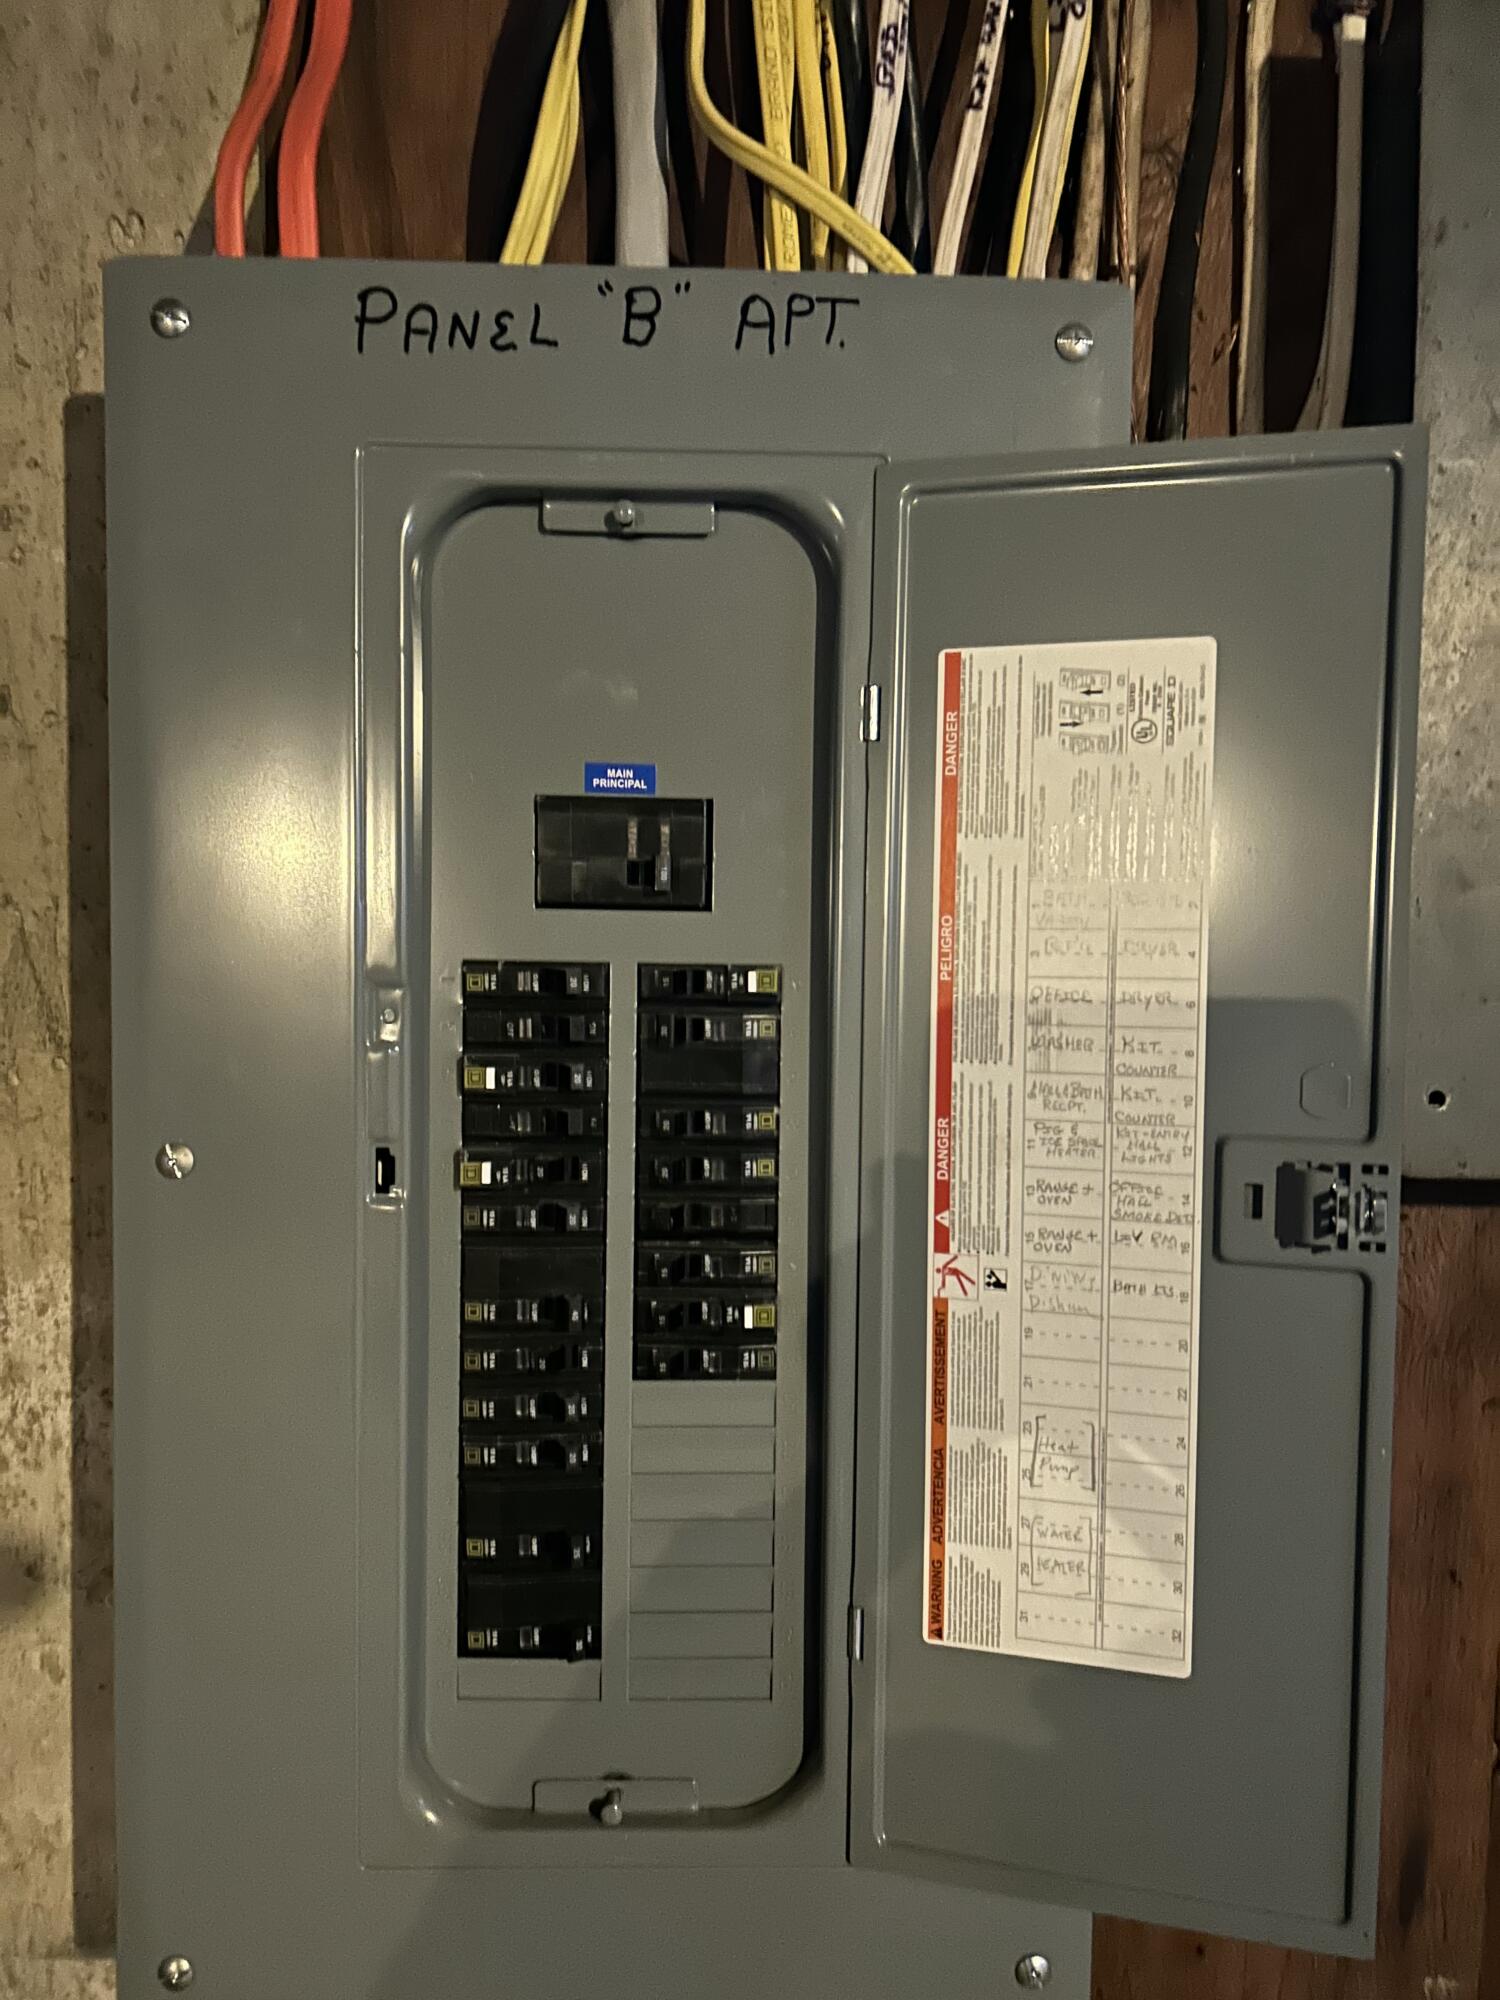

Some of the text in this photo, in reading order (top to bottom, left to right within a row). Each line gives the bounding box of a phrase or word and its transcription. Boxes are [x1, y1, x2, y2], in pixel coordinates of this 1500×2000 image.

[764, 47, 783, 120] BRAND
[356, 285, 558, 356] PANEL
[736, 294, 861, 356] APT.
[1165, 674, 1175, 747] SQUARE D
[944, 710, 958, 776] DANGER
[606, 768, 634, 779] MAIN
[592, 778, 648, 789] PRINCIPAL
[939, 915, 954, 982] PELIGRO
[1116, 1062, 1178, 1077] COUNTER
[574, 1073, 581, 1084] 20
[1184, 1094, 1193, 1110] 10
[1114, 1111, 1176, 1126] COUNTER
[936, 1117, 949, 1181] DANGER
[1027, 1138, 1036, 1150] 11
[1182, 1145, 1193, 1158] 12
[1121, 1151, 1172, 1165] LIGHTS
[1026, 1184, 1035, 1197] 13
[1037, 1194, 1073, 1206] OVEN
[1117, 1194, 1152, 1208] HALL
[1182, 1193, 1191, 1207] 14
[1024, 1231, 1035, 1243] 15
[1033, 1242, 1072, 1253] OVEN
[1180, 1241, 1190, 1255] 16
[1024, 1279, 1034, 1292] 17
[1179, 1291, 1189, 1304] 18
[1023, 1326, 1034, 1339] 19
[1178, 1338, 1188, 1354] 20
[933, 1309, 946, 1425] AVERTISSEMENT
[1023, 1376, 1033, 1389] 21
[1177, 1386, 1188, 1402] 22
[1022, 1420, 1032, 1436] 23
[1038, 1436, 1079, 1455] Heat
[1176, 1436, 1187, 1451] 24
[1021, 1467, 1031, 1481] 25
[1039, 1456, 1080, 1481] Pump
[932, 1447, 945, 1545] ADVERTENCIA
[1175, 1484, 1185, 1499] 26
[1020, 1515, 1030, 1530] 27
[1037, 1527, 1084, 1543] WATER
[1174, 1532, 1184, 1548] 28
[1020, 1562, 1030, 1577] 29
[1036, 1555, 1086, 1577] HEATER
[930, 1559, 943, 1625] WARNING
[1172, 1580, 1183, 1595] 30
[1019, 1610, 1029, 1623] 31
[1171, 1629, 1182, 1644] 32
